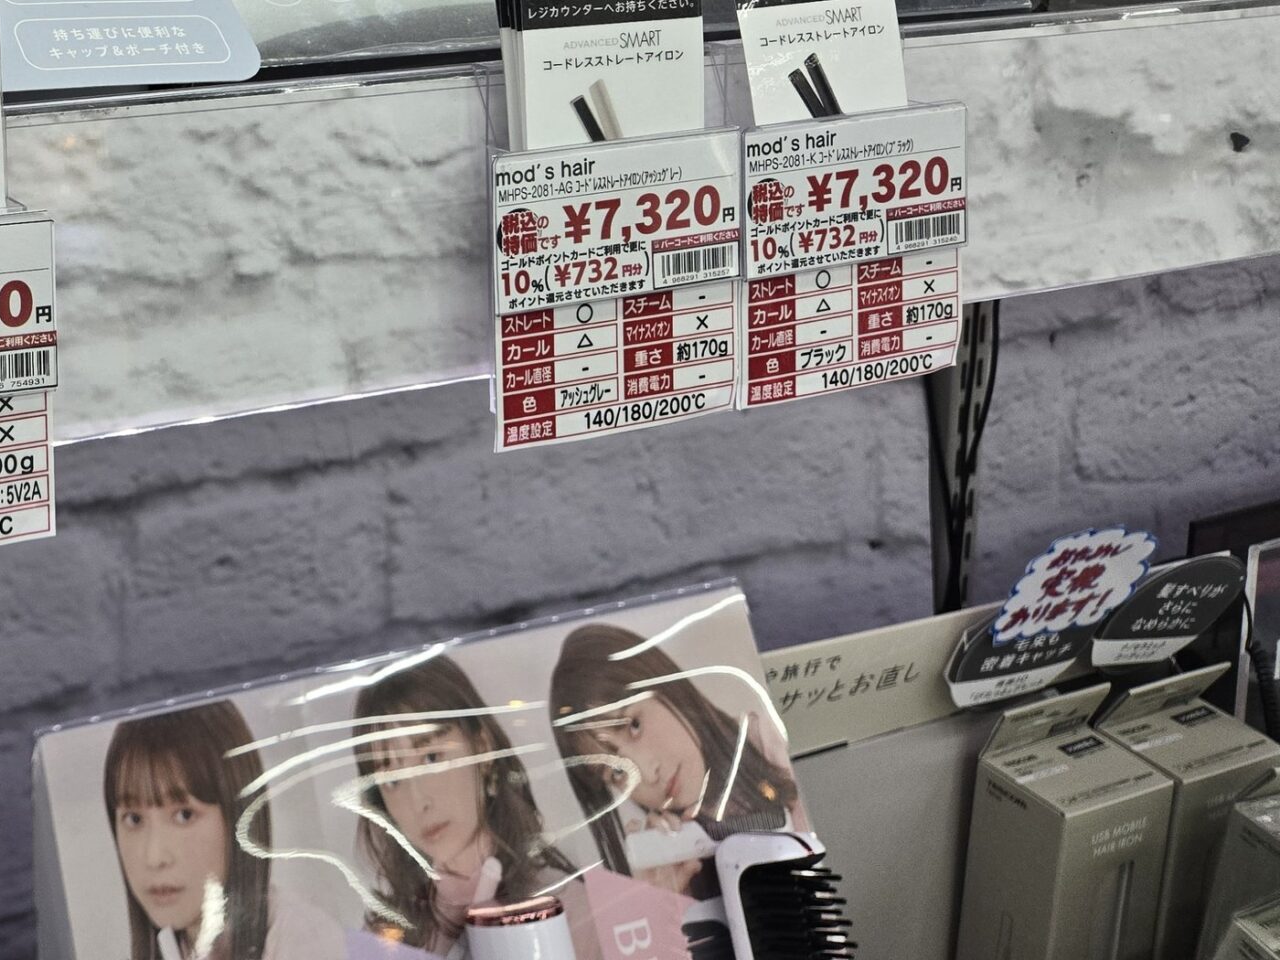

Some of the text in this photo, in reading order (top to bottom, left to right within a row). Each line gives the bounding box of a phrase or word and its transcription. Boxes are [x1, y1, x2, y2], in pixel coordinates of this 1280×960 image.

[52, 25, 187, 42] 持ち運びに便利な
[759, 24, 885, 48] コードレスストレートアイロン
[543, 48, 685, 72] コードレスストレートアイロン
[747, 130, 837, 158] mod's hair
[496, 157, 596, 186] mod's hair
[749, 152, 816, 173] MHPS-2081-K
[499, 179, 573, 203] MHPS-2081-AG
[751, 208, 882, 238] ゴールドポイントカードご利用で更に
[501, 241, 646, 271] ゴールドポイントカードご利用で更に
[757, 245, 880, 275] ポイント還元させていただきます
[752, 259, 902, 300] ストレート スチーム
[509, 280, 645, 310] ポイント還元させていただきます
[753, 284, 901, 325] カール マイナスイオン
[505, 311, 551, 334] ストレート
[867, 300, 953, 329] 重さ 約170g
[626, 320, 671, 341] マイナスイオン
[676, 338, 728, 362] 約170g
[800, 334, 901, 369] ブラック 消費電力
[751, 352, 933, 401] 温度設定 140/180/200℃
[560, 383, 611, 408] アッシュグレー
[583, 392, 706, 430] 140/180/200℃
